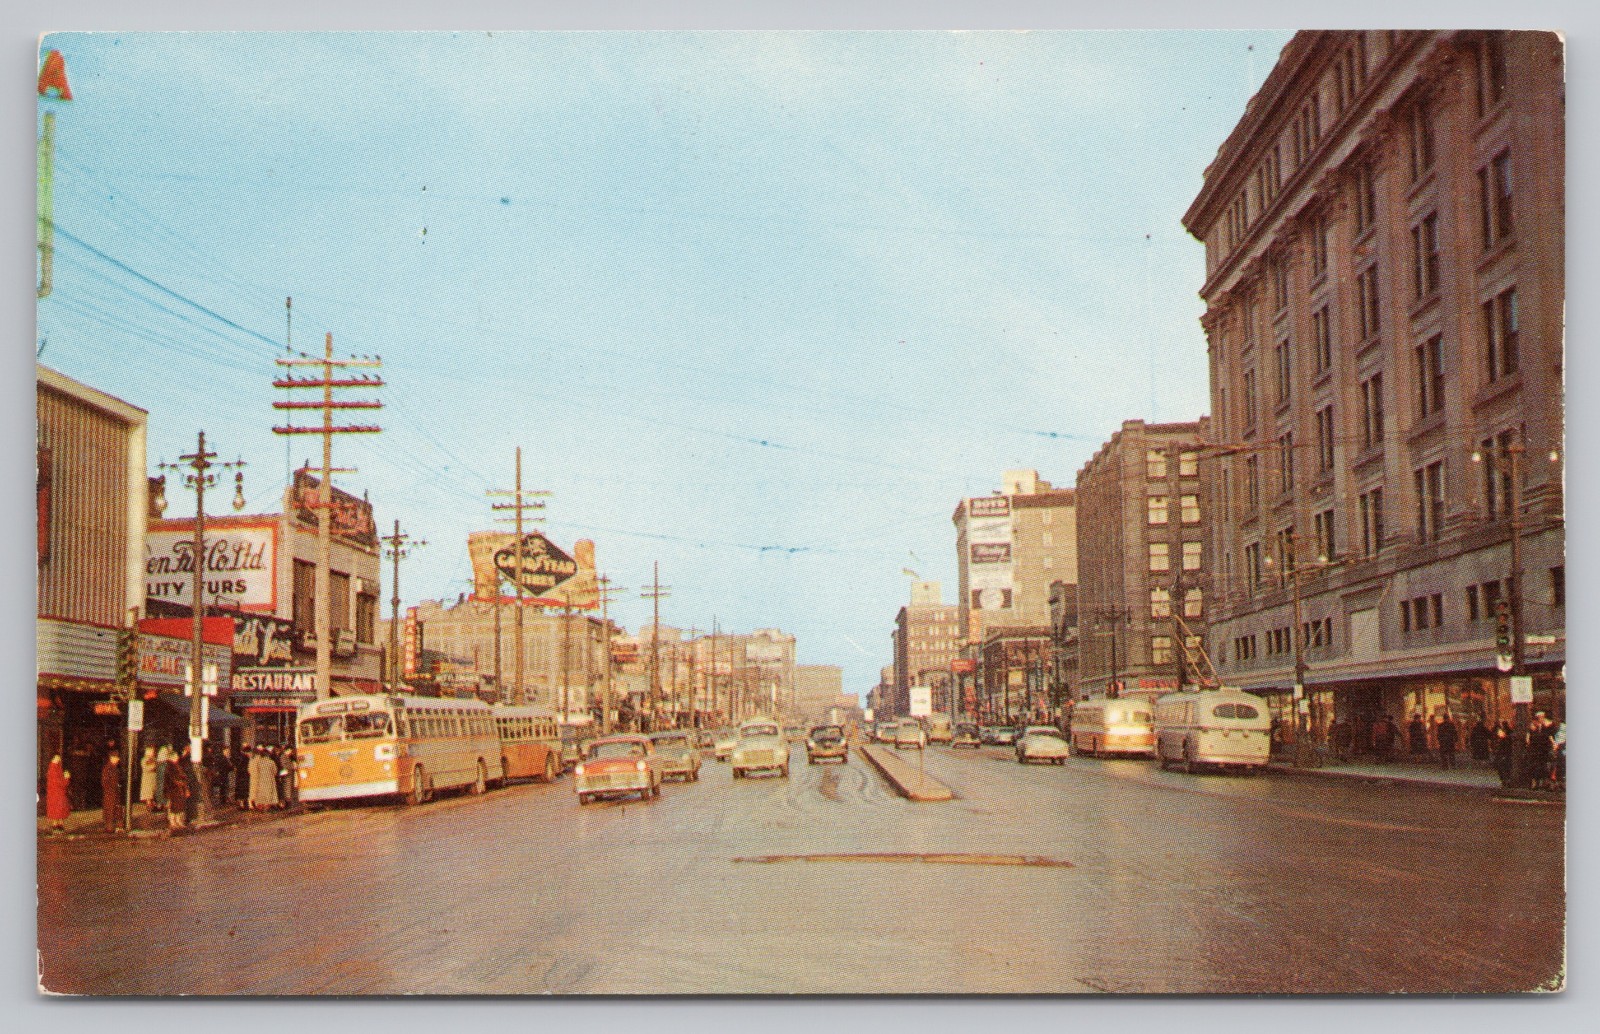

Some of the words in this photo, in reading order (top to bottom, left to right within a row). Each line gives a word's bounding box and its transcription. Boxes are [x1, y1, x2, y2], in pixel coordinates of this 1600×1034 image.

[147, 581, 185, 596] LITY
[201, 578, 247, 595] URS
[232, 673, 317, 690] RESTAURANT
